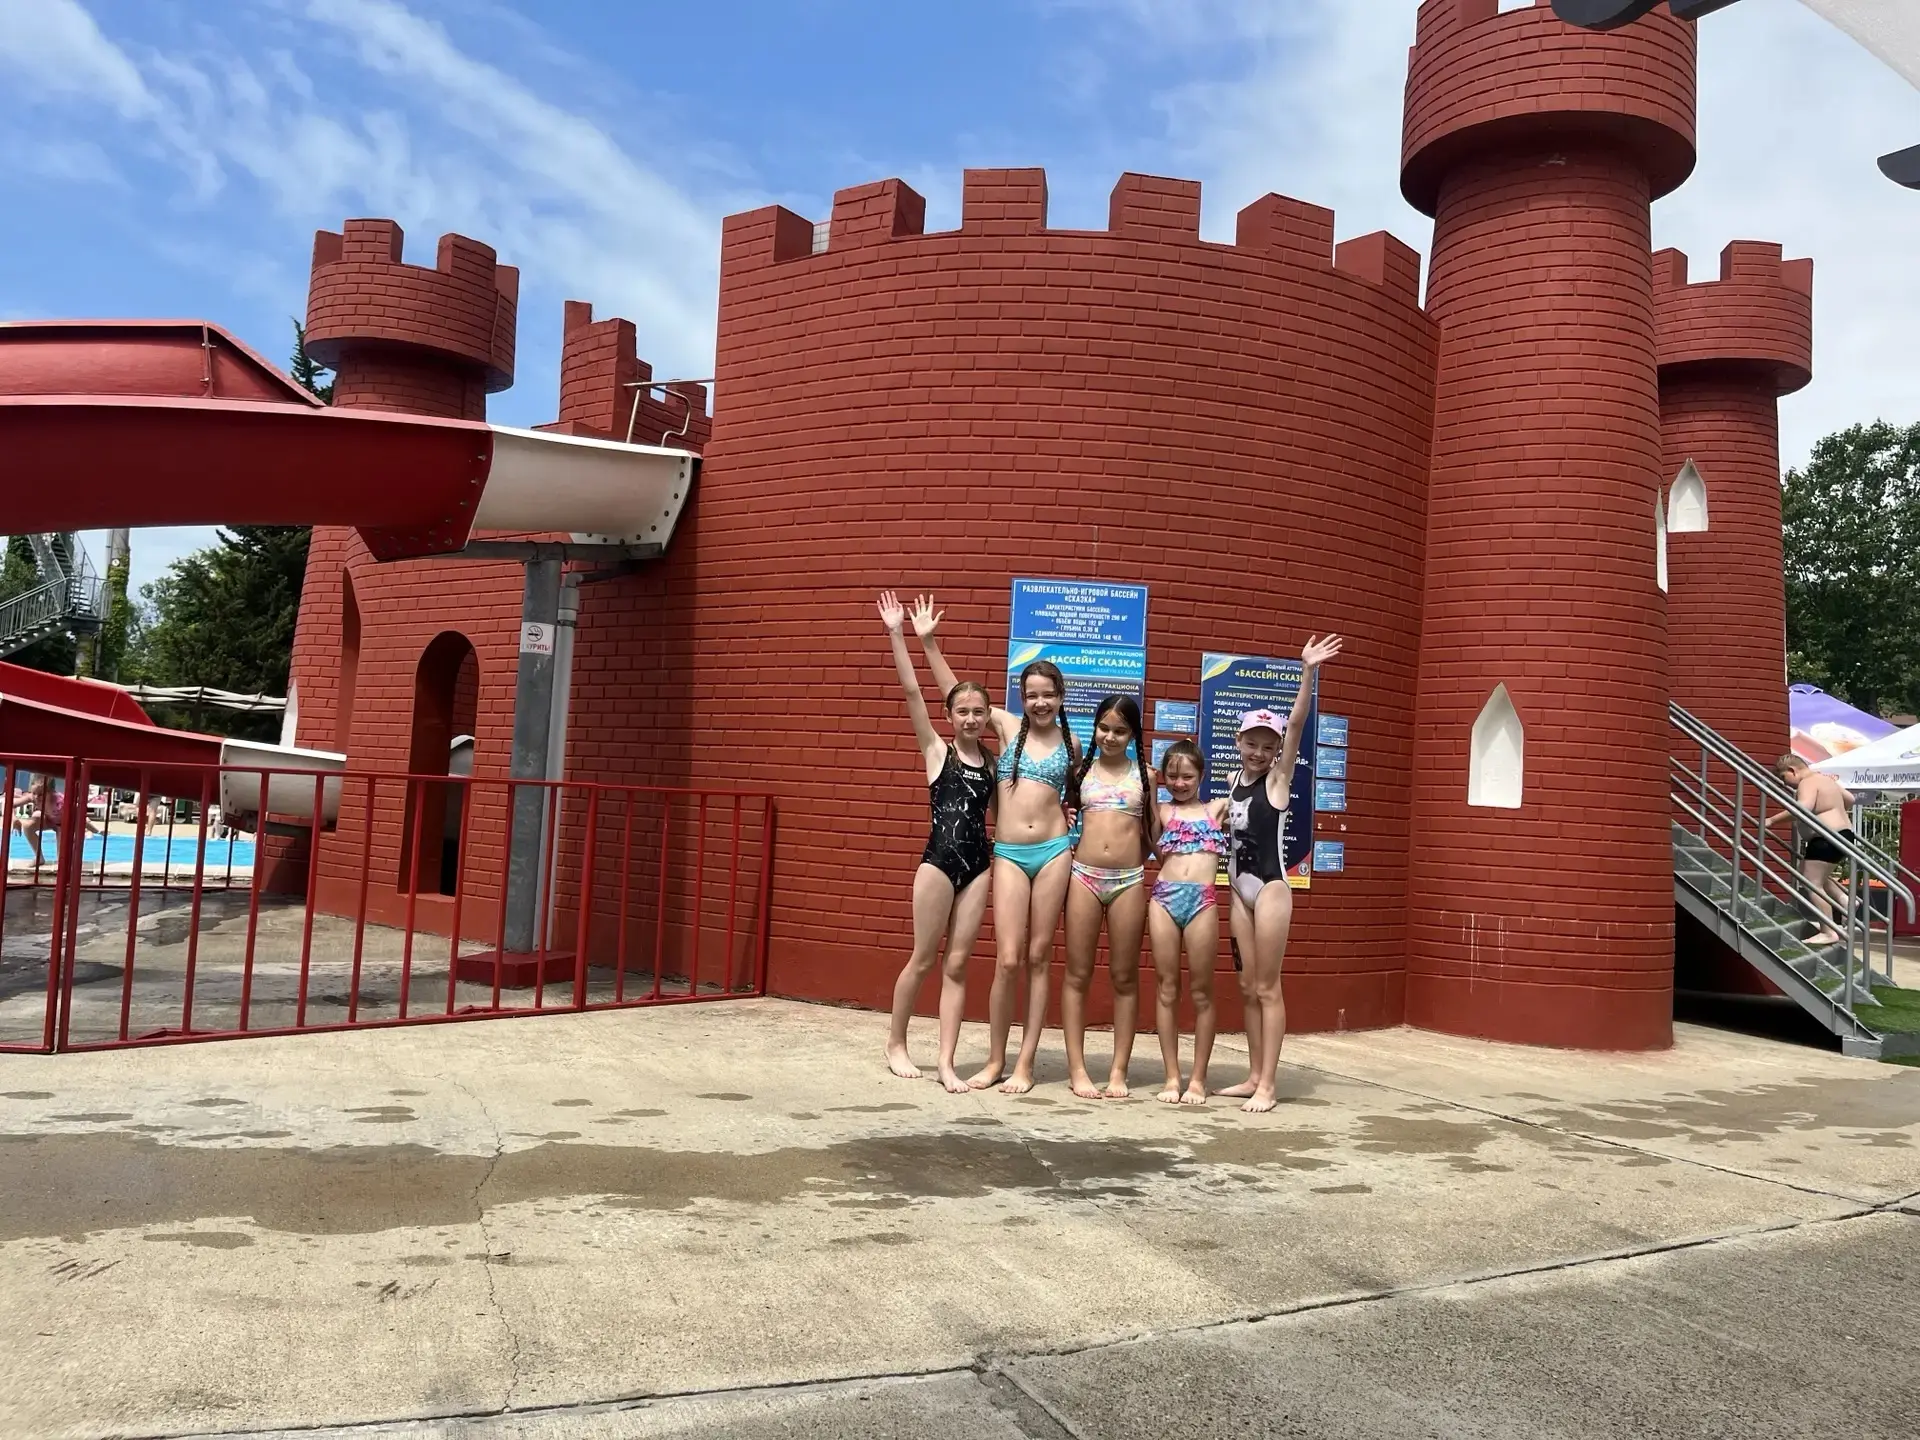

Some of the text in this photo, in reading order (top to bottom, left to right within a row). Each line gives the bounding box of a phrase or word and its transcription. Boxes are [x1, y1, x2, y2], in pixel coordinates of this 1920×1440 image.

[1022, 585, 1138, 599] РАЗВЛЕКАТЕЛЬНО-ИГРОВОЙ БАССЕЙН
[1065, 595, 1096, 603] «СКАЗКА»
[1045, 655, 1142, 668] «БАССЕЙН СКАЗКА»
[1235, 669, 1303, 682] «БАССЕЙН СКАЗ
[1093, 682, 1139, 690] АТТРАКЦИОНА
[1213, 708, 1243, 716] «РАДУГА
[1211, 752, 1242, 761] «КРОЛИ
[1850, 768, 1889, 783] Любимое
